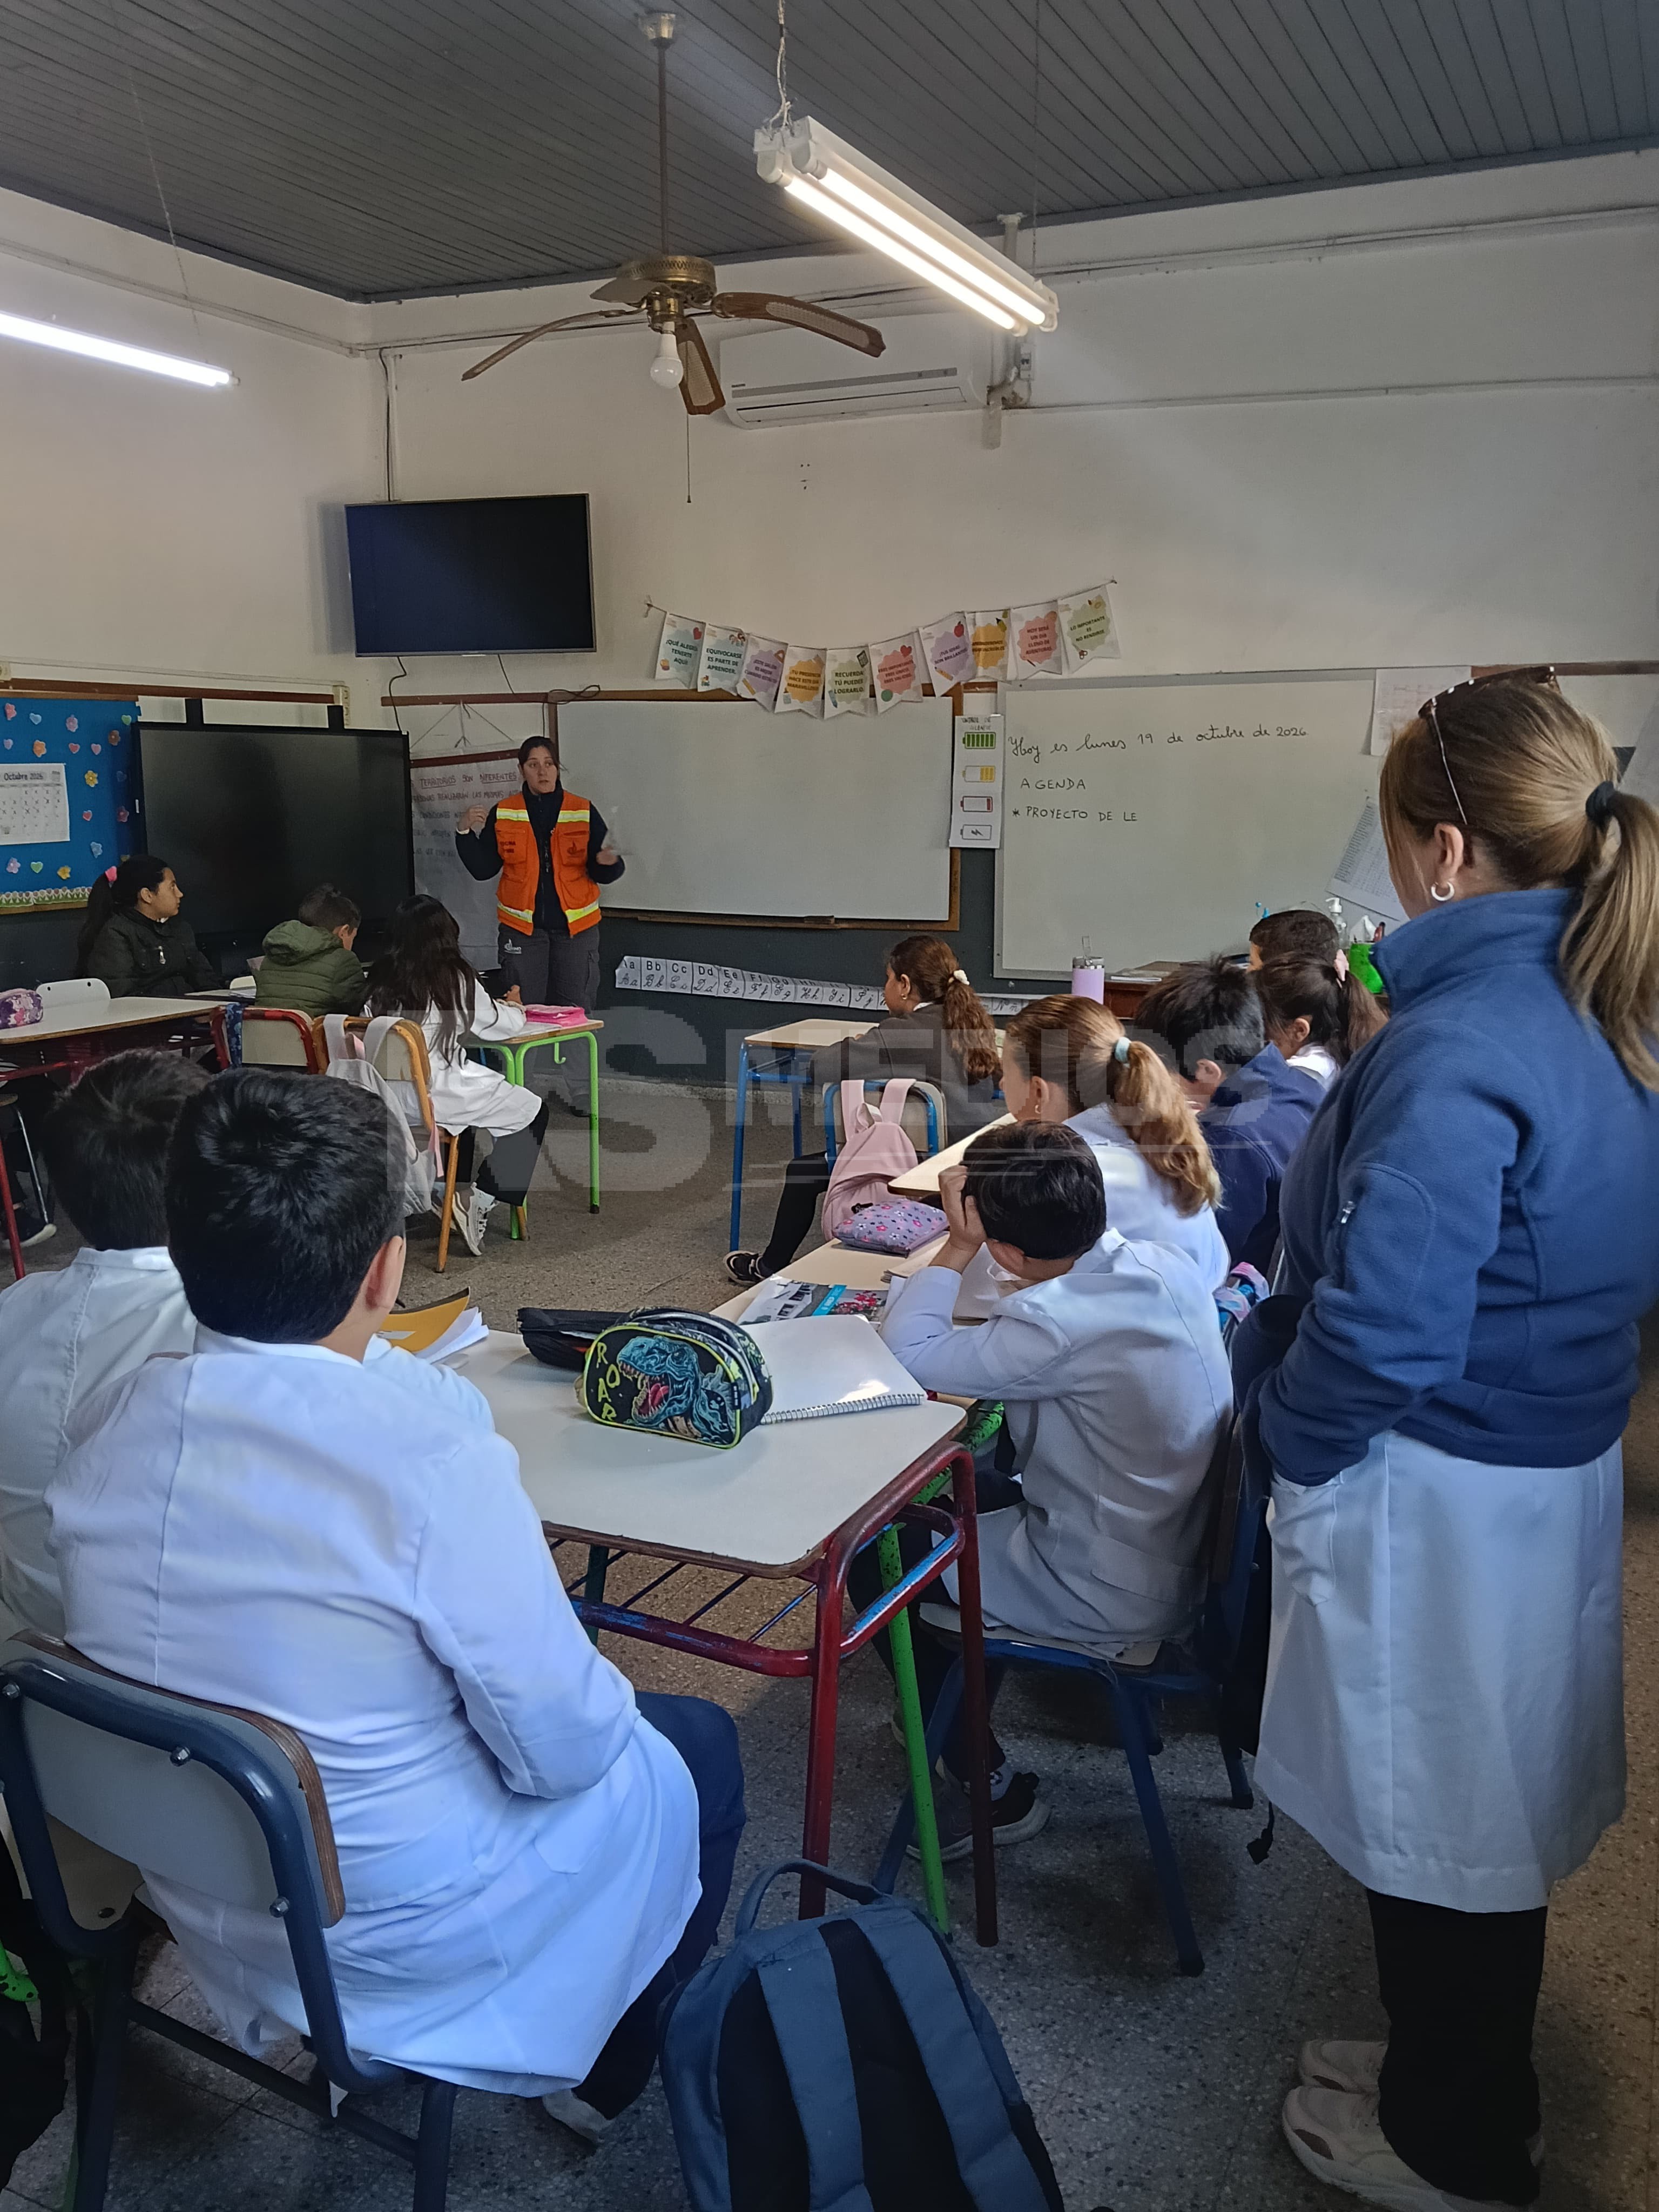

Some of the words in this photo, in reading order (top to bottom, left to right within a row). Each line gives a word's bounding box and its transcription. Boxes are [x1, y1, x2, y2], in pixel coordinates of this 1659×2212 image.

[1077, 616, 1105, 628] IMPORTANTE
[706, 649, 742, 659] EQUIVOCARSE
[1008, 737, 1041, 763] Hoy
[1050, 744, 1068, 753] es
[1076, 734, 1126, 751] lunes
[1138, 733, 1153, 744] 19
[1167, 732, 1183, 744] de
[1196, 725, 1244, 741] octubre
[1253, 724, 1270, 737] de
[4, 772, 28, 780] Octubre
[1021, 778, 1085, 790] AGENDA
[1026, 806, 1088, 819] PROYECTO
[1099, 811, 1112, 821] DE
[1123, 812, 1137, 821] LE
[596, 1342, 621, 1421] ROAR
